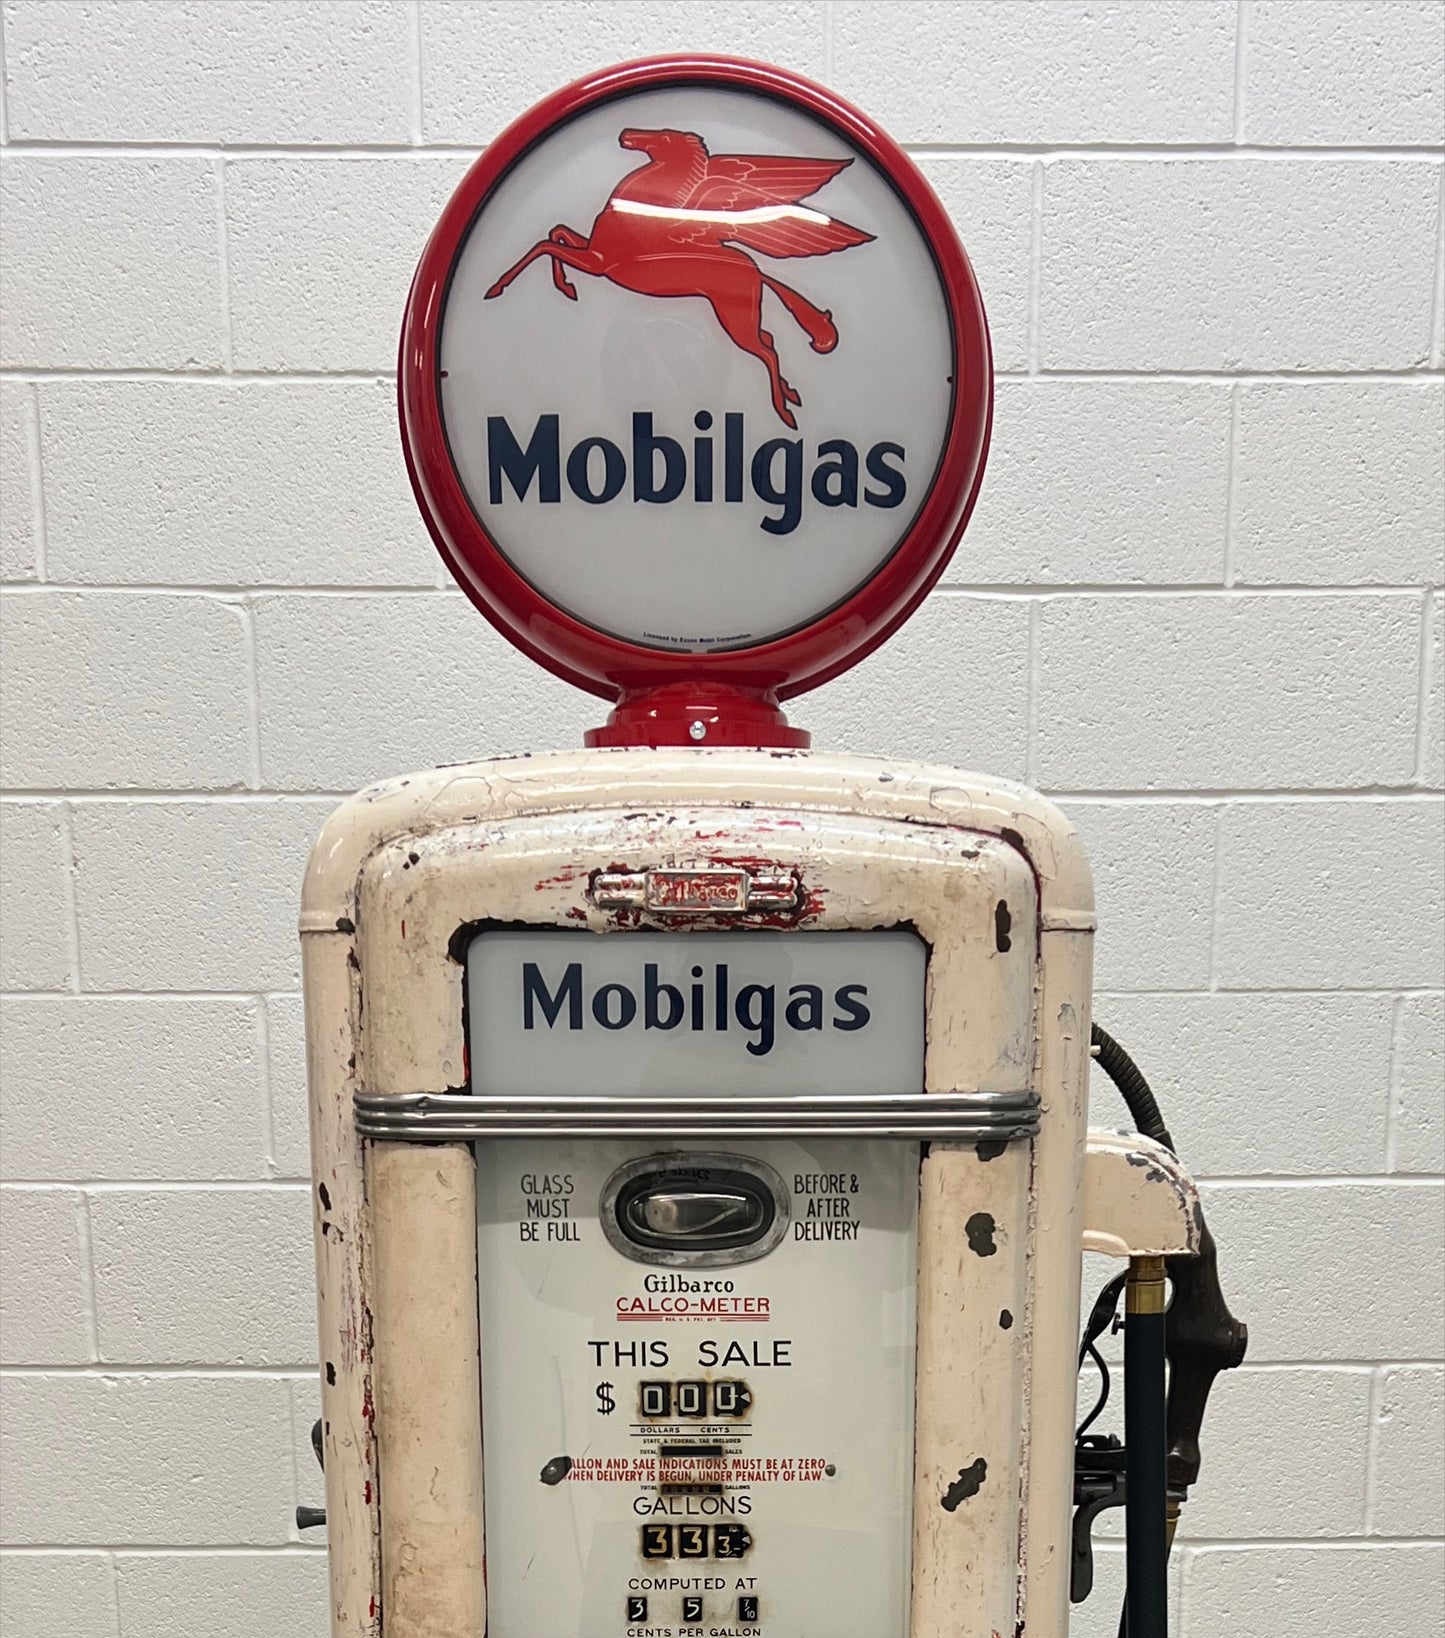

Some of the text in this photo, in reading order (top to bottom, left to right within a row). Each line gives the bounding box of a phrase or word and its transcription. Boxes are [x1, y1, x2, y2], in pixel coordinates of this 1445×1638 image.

[486, 411, 907, 535] Mobilgas
[522, 962, 871, 1056] Mobilgas
[520, 1174, 574, 1195] GLASS
[794, 1174, 860, 1194] BEFORE &
[527, 1199, 570, 1218] MUST
[806, 1199, 850, 1218] AFTER
[520, 1222, 580, 1242] BE FULL
[794, 1221, 860, 1242] DELIVERY
[644, 1274, 734, 1293] Gilbarco
[616, 1297, 770, 1312] CALCO-METER
[588, 1341, 792, 1367] THIS SALE
[596, 1381, 616, 1416] $
[571, 1458, 826, 1470] ALLON AND SALE INDICATIONS MUST BE AT ZERO
[597, 1470, 643, 1481] DELIVERY
[647, 1470, 656, 1481] IS
[660, 1470, 696, 1482] BEGUN,
[699, 1470, 733, 1481] UNDER
[735, 1470, 780, 1481] PENALTY
[783, 1470, 796, 1481] OF
[633, 1496, 752, 1515] GALLONS
[628, 1577, 758, 1590] COMPUTED AT
[627, 1628, 761, 1637] CENTS PER GALLON
